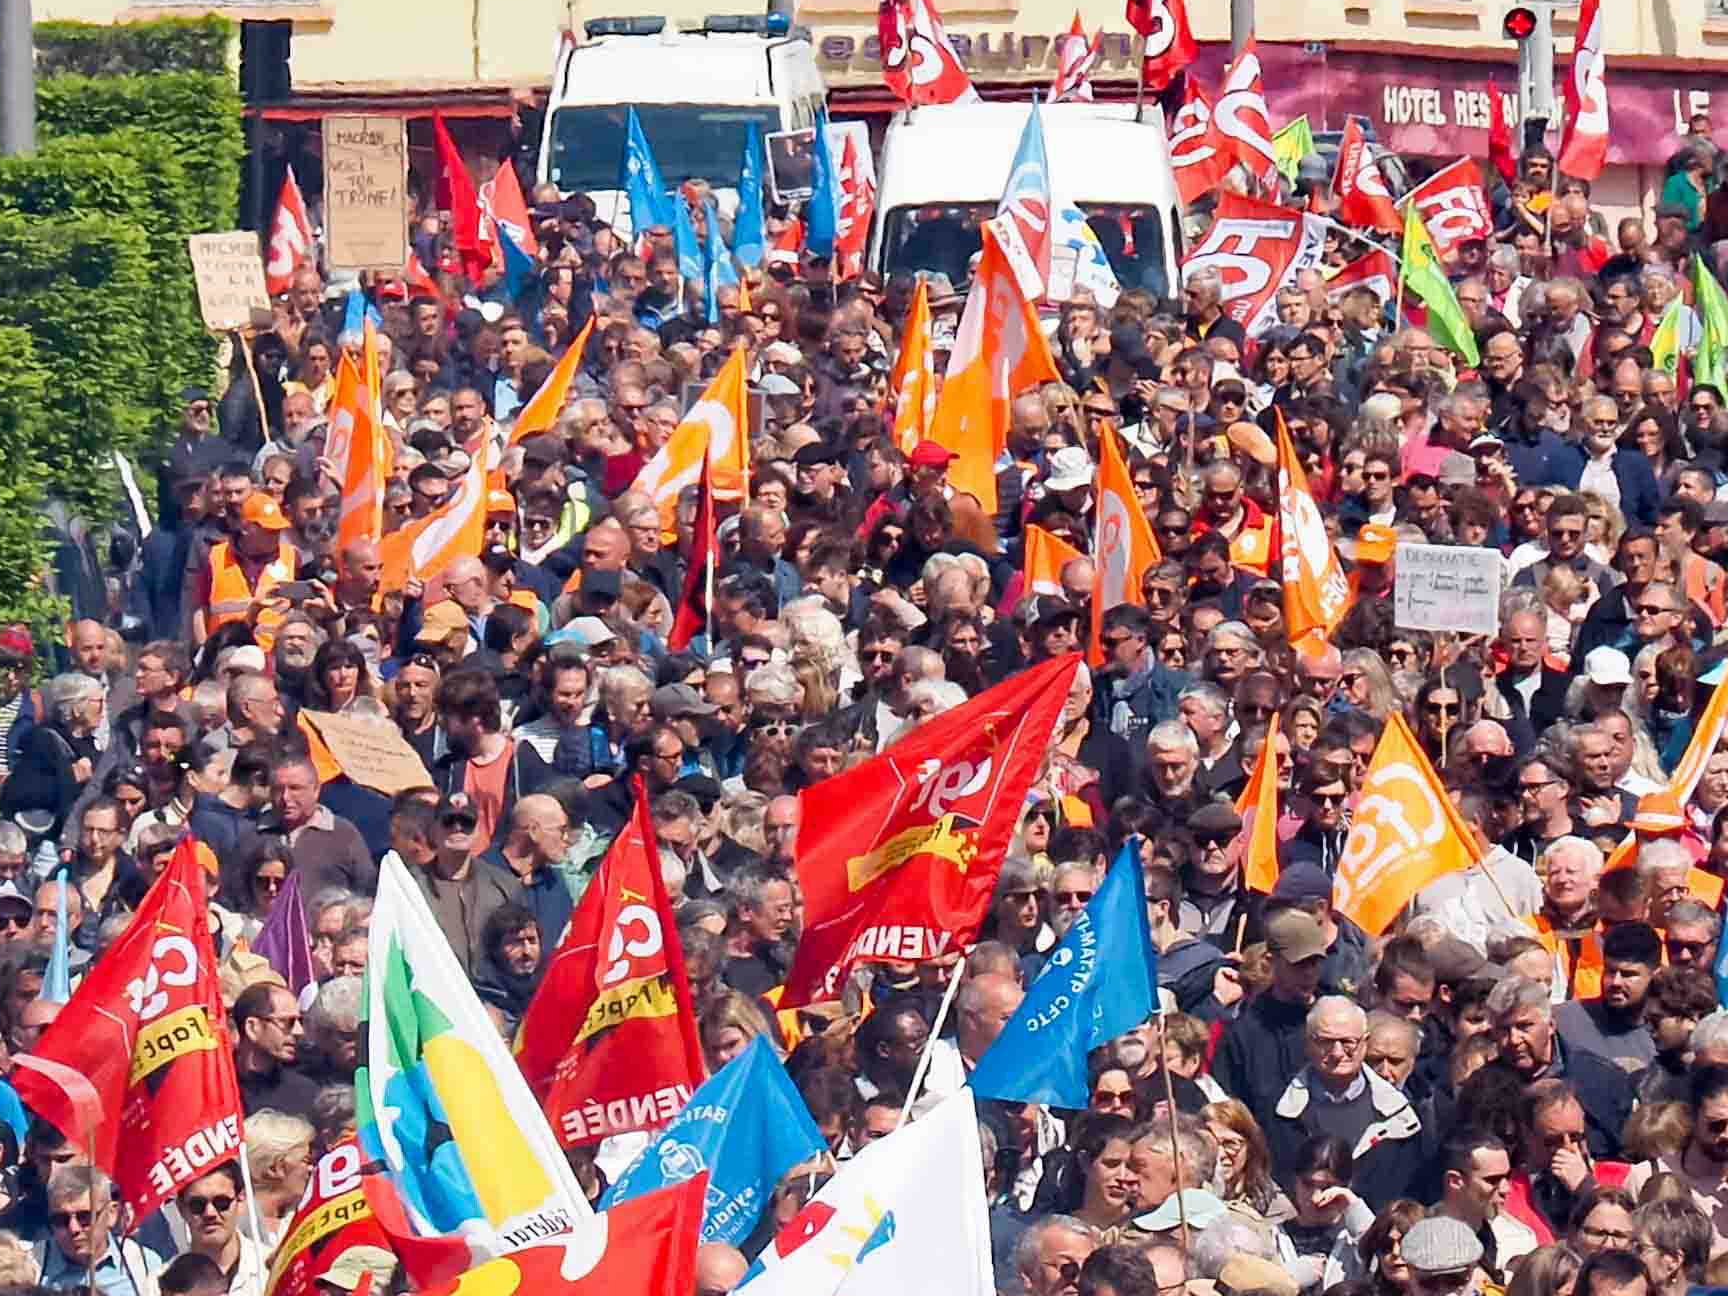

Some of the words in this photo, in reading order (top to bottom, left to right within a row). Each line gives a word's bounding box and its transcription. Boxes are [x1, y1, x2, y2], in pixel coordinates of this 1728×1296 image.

[1383, 84, 1447, 125] HOTEL
[1071, 910, 1097, 993] TI-MAT-TP
[1026, 995, 1070, 1032] CFTC
